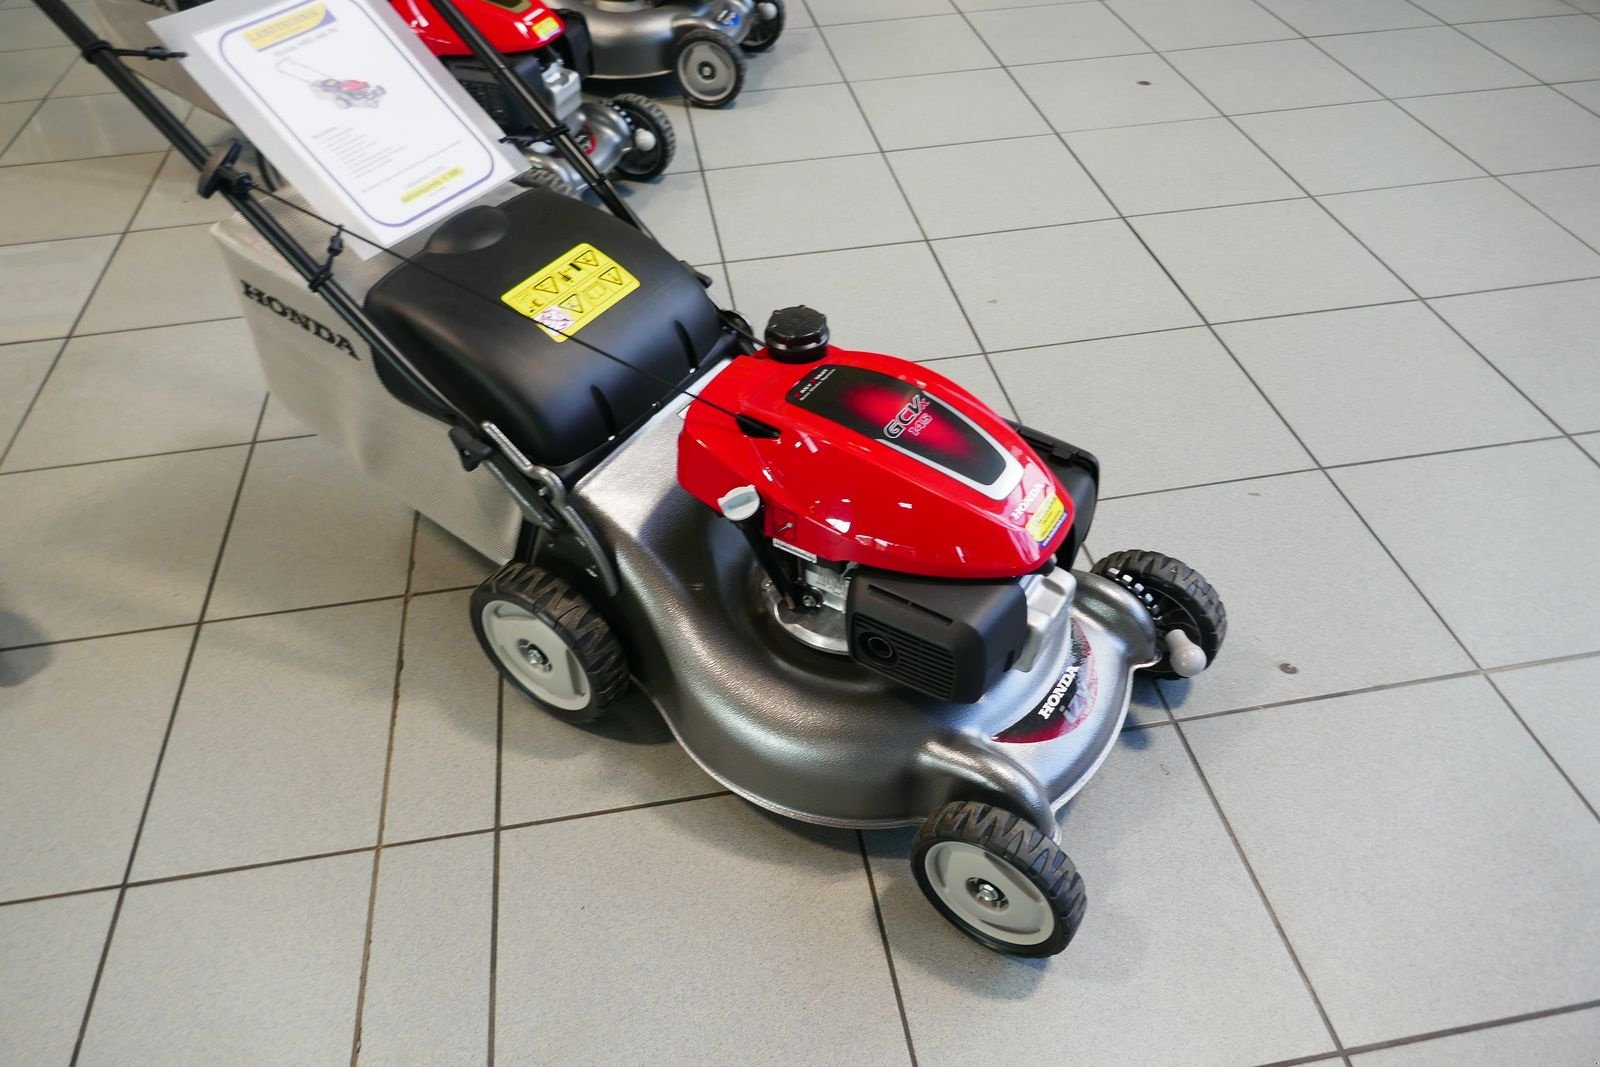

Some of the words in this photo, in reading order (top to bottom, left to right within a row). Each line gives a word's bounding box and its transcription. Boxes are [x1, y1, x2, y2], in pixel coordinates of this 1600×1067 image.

[240, 280, 361, 361] HONDA
[908, 412, 933, 436] 145
[1010, 482, 1046, 520] HONDA
[1038, 666, 1080, 719] HONDA
